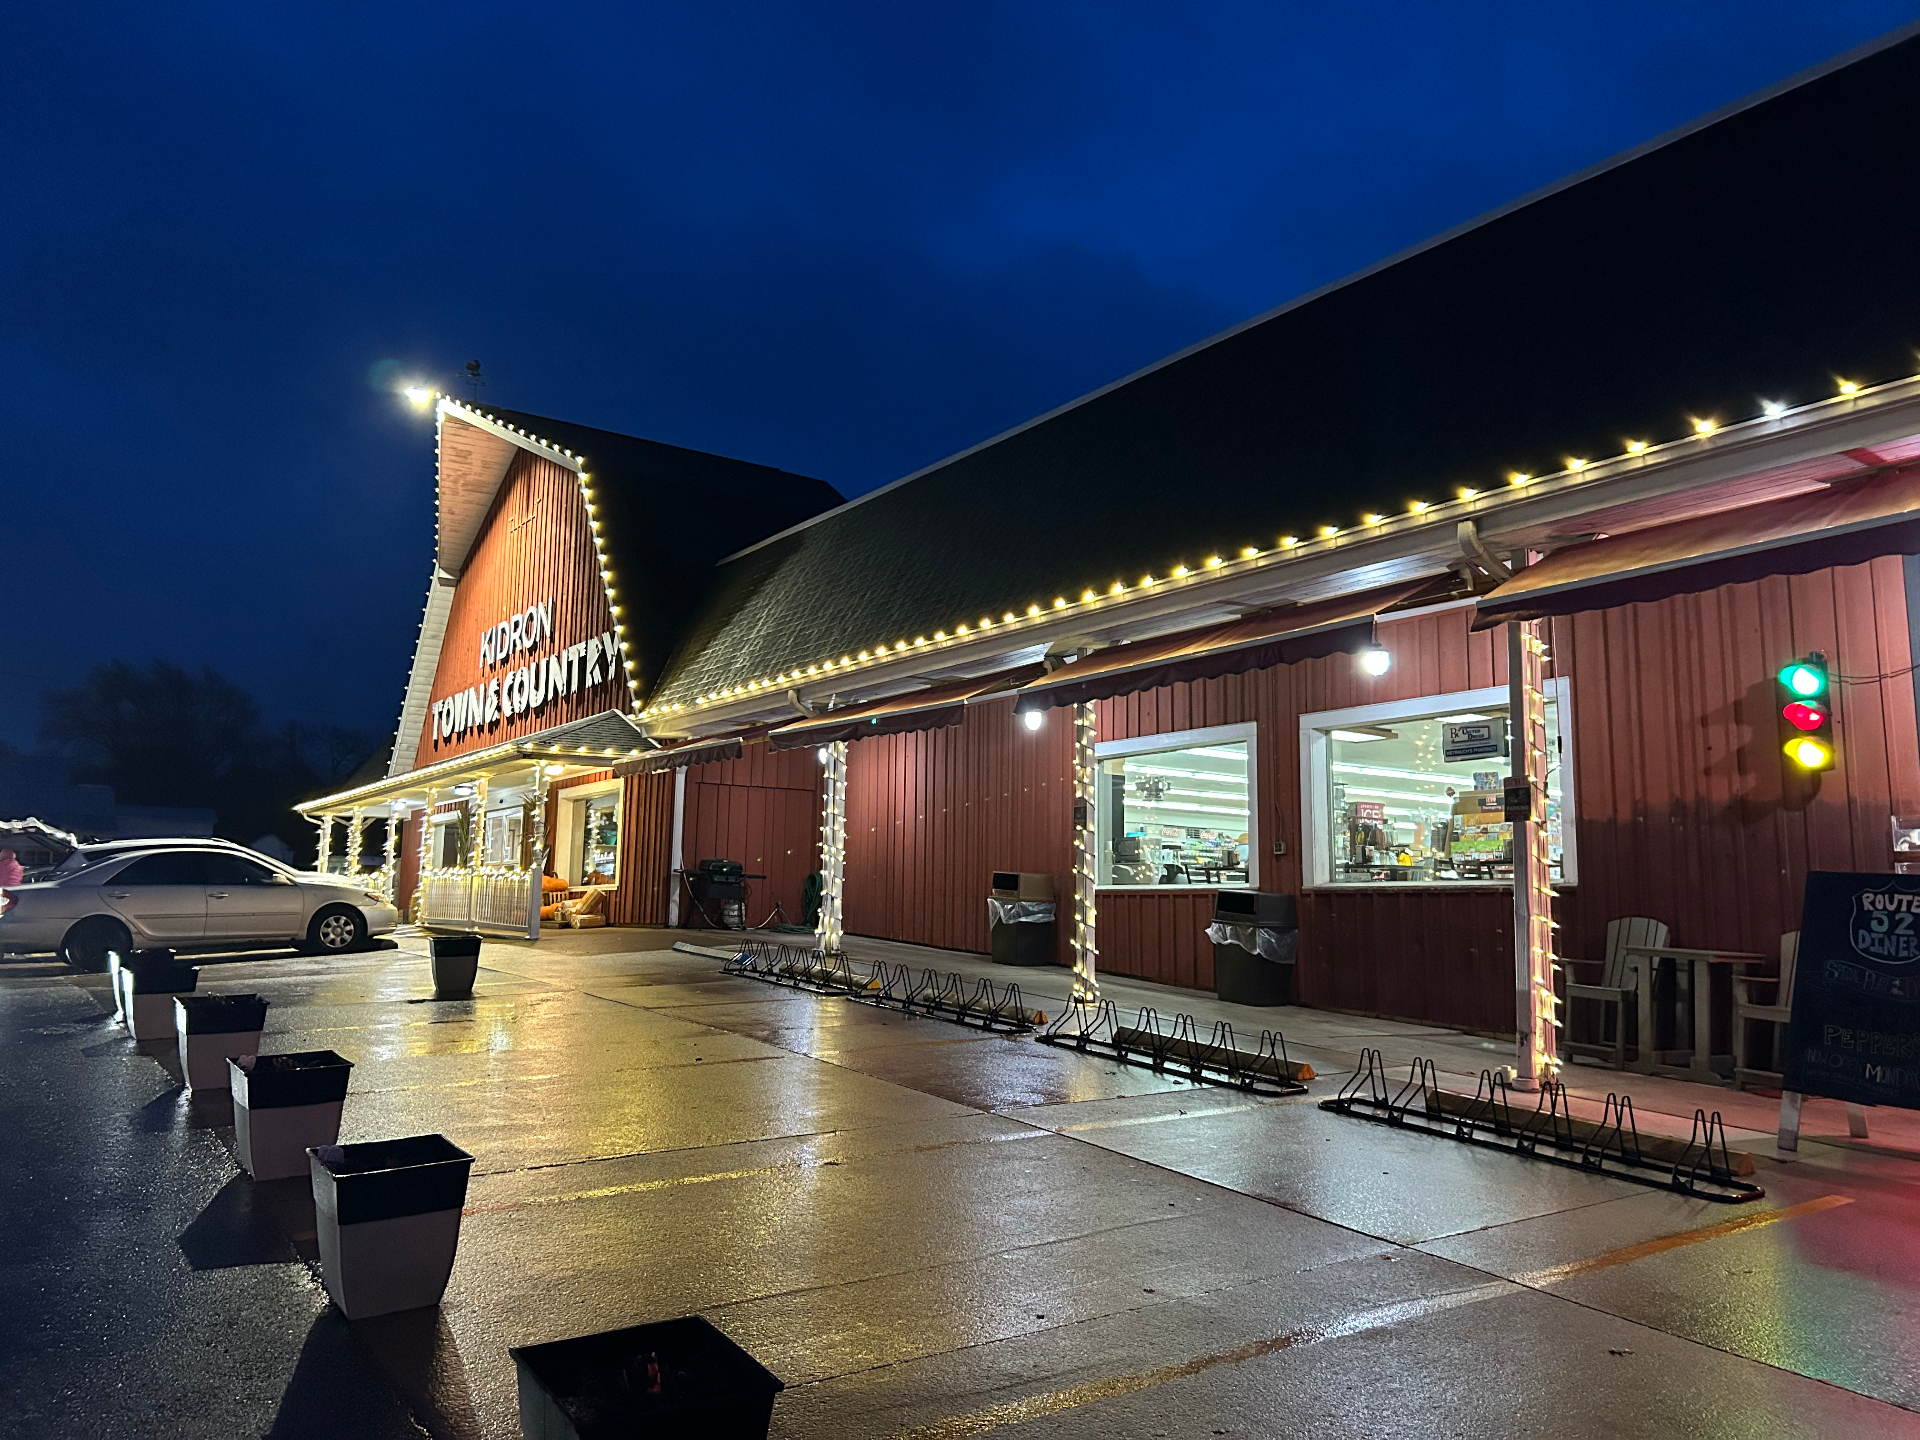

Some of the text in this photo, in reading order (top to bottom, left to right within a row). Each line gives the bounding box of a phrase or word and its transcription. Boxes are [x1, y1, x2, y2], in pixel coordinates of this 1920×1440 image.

[479, 596, 553, 668] KIDRON
[432, 631, 621, 740] TOWN & COUNTRY
[1861, 892, 1920, 914] ROUTE
[1870, 910, 1915, 935] 52
[1858, 929, 1920, 957] DINER
